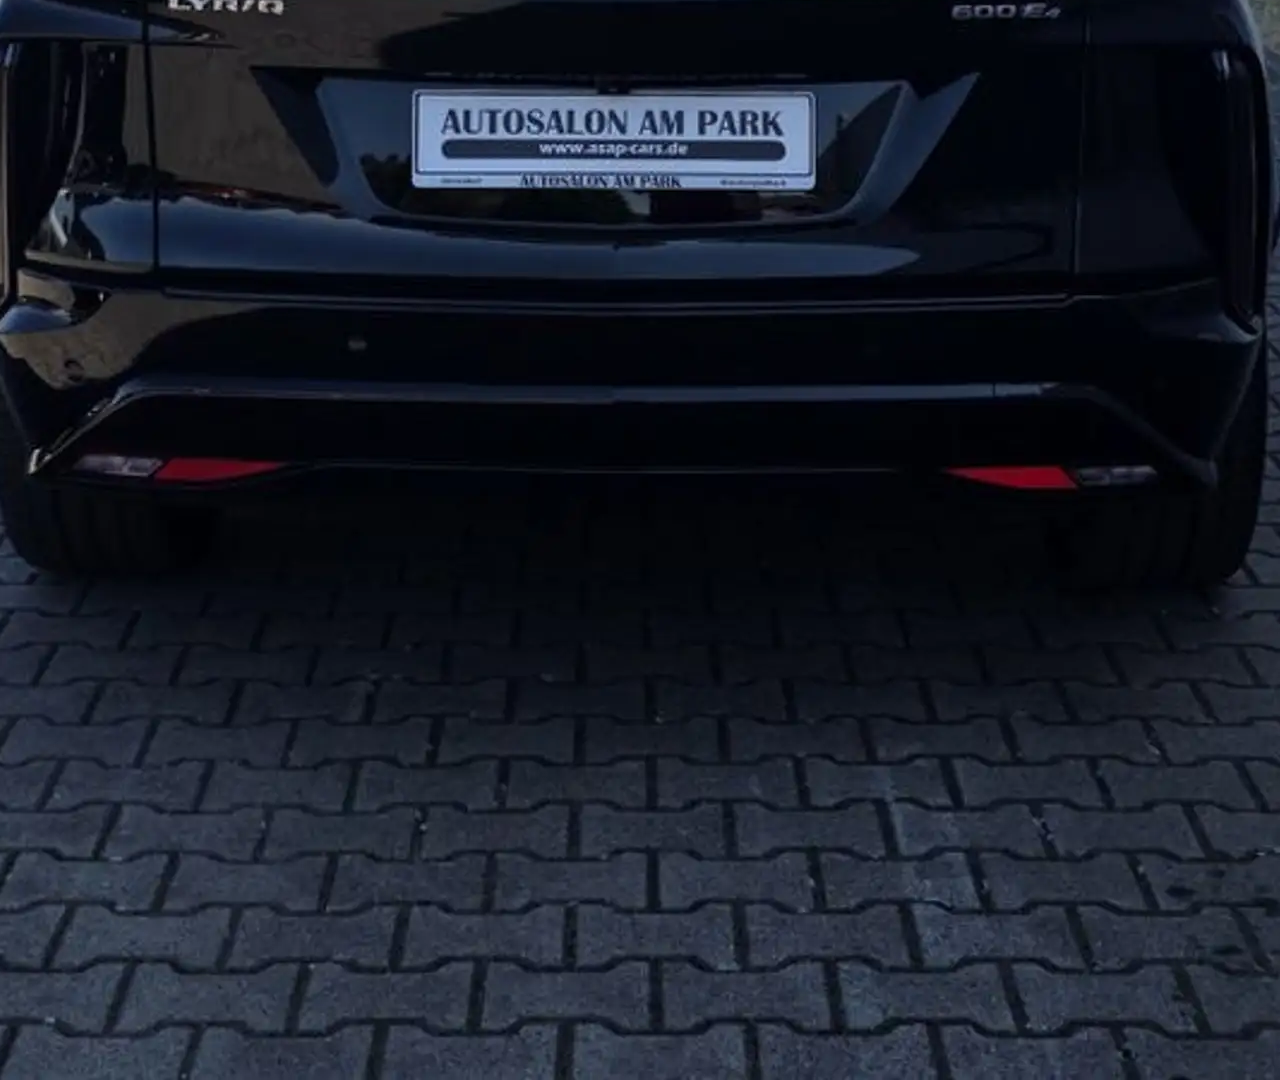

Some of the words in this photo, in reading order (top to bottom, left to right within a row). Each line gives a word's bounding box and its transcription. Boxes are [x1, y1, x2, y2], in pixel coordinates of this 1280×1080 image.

[951, 3, 1017, 20] 600
[441, 108, 628, 136] AUTOSALON
[638, 109, 685, 136] AM
[697, 109, 785, 137] PARK
[539, 142, 689, 158] www.asap-cars.de
[520, 174, 610, 188] AUTOSALON
